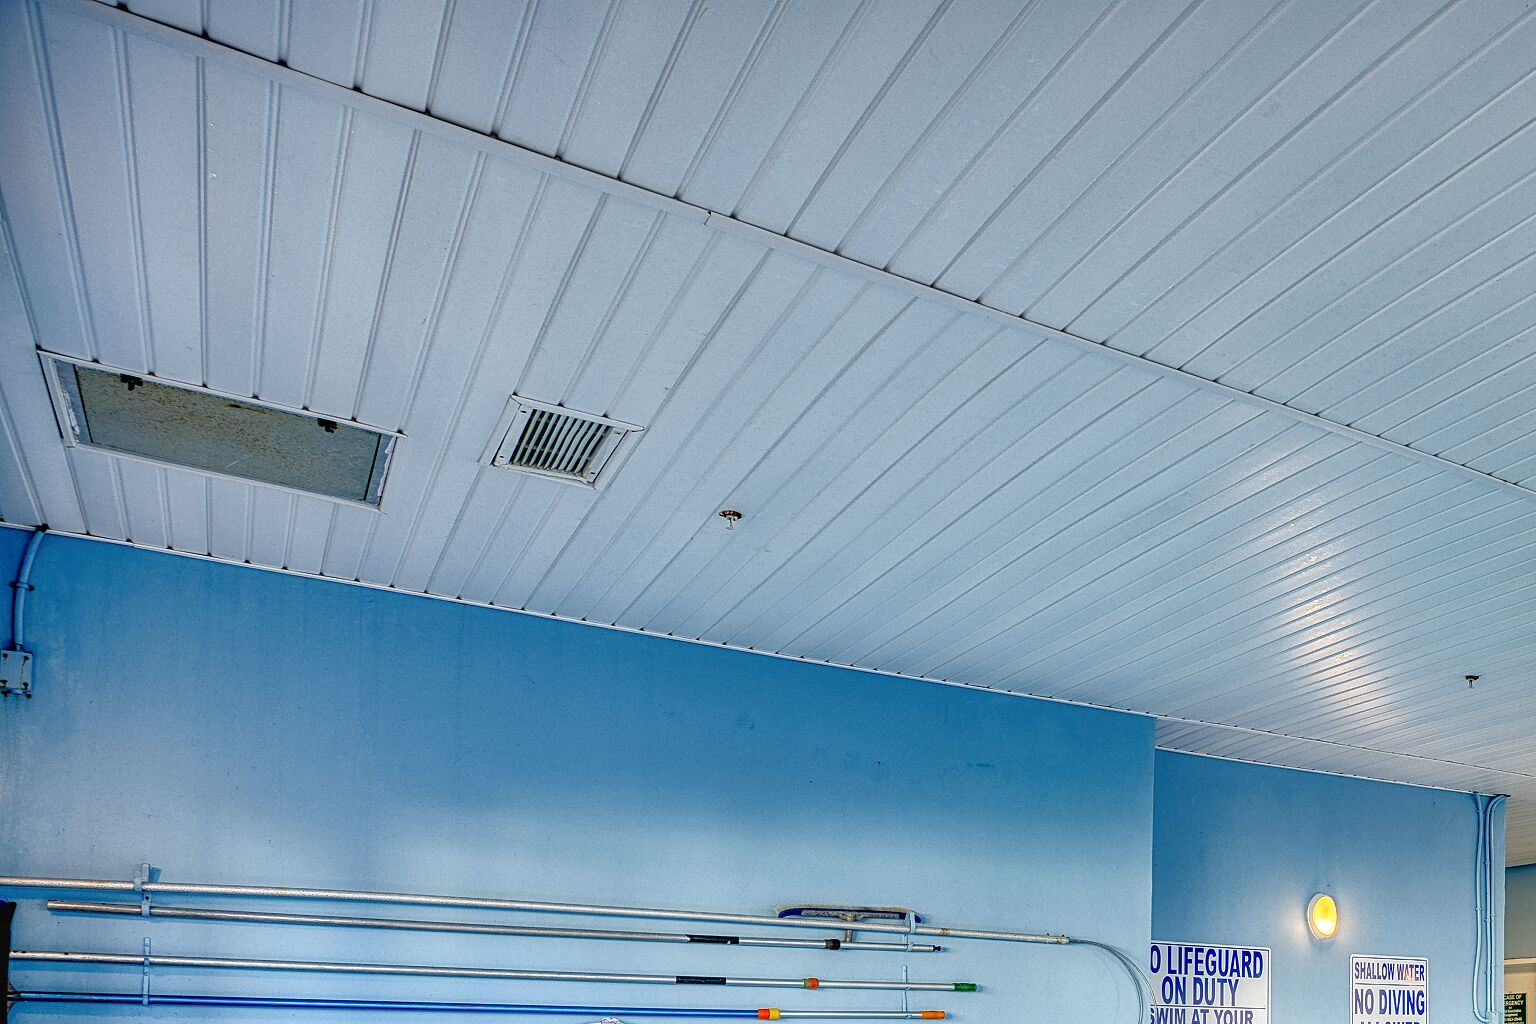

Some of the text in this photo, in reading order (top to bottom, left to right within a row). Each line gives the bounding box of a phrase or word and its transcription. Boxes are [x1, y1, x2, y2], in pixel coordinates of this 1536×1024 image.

[1151, 945, 1263, 979] O LIFEGUARD
[1354, 962, 1425, 982] SHALLOW WATER
[1161, 976, 1239, 1006] ON DUTY
[1354, 988, 1425, 1015] NO DIVING
